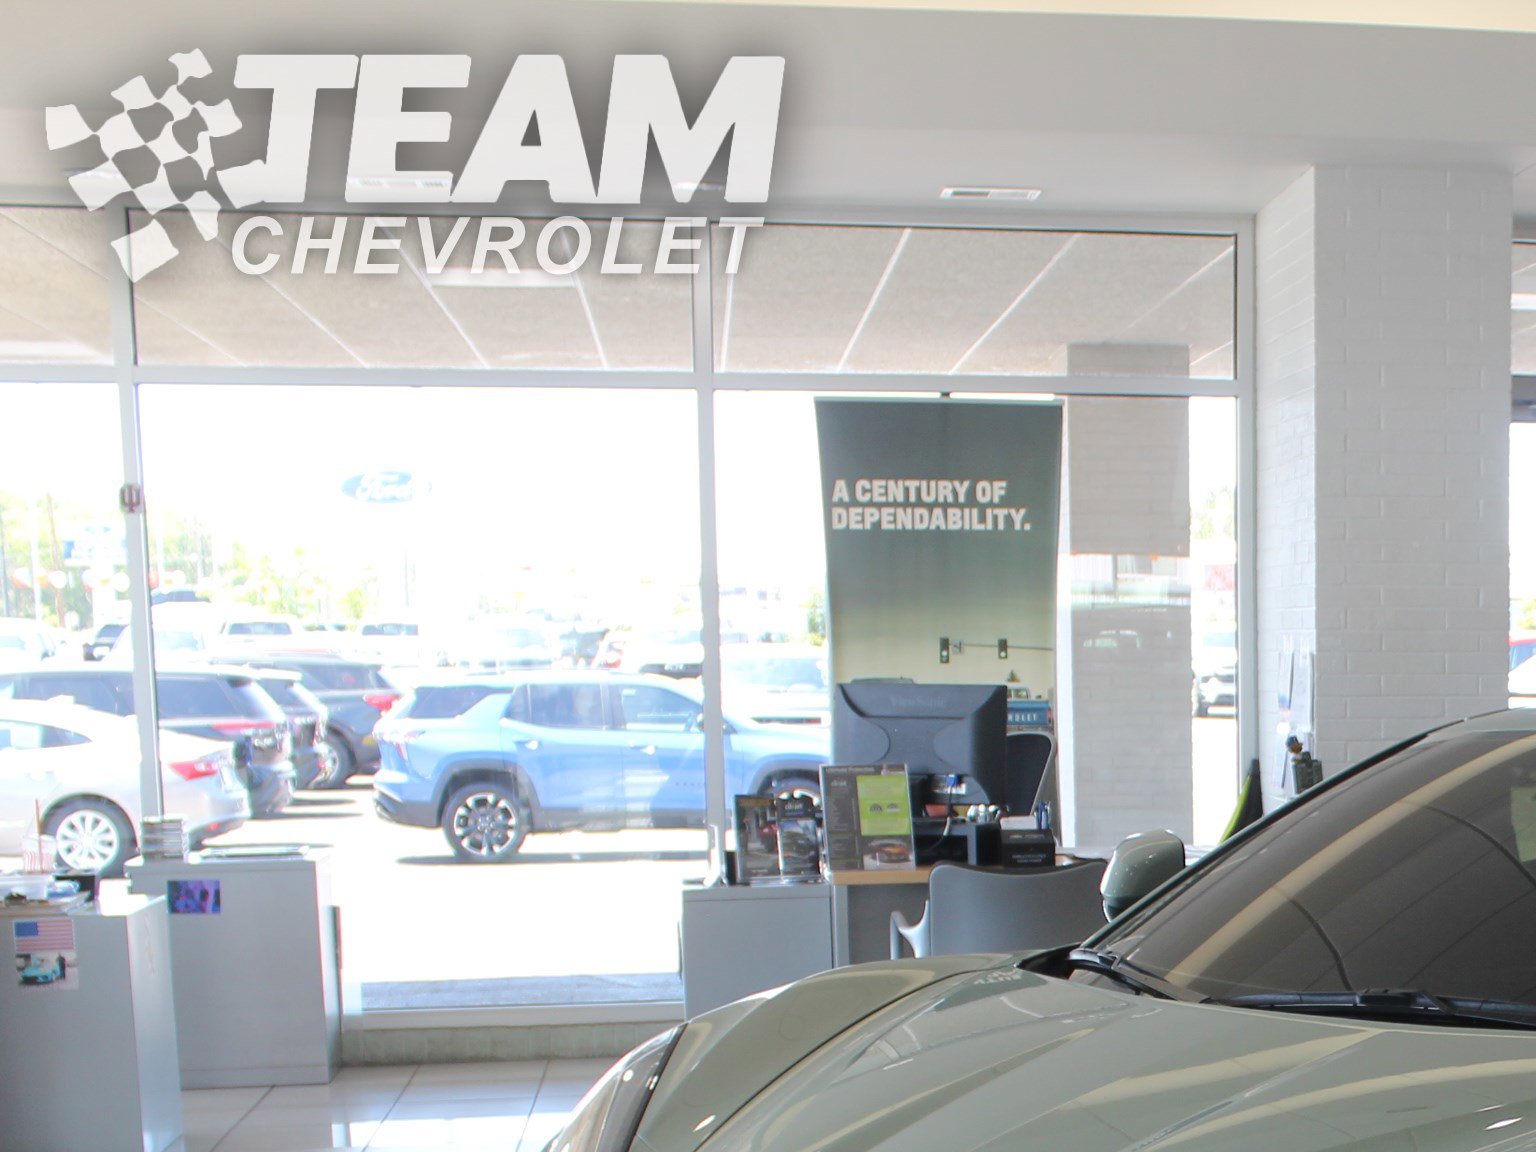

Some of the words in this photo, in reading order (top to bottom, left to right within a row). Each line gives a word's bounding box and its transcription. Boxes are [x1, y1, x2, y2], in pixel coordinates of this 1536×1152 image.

[832, 479, 850, 503] A
[854, 479, 970, 504] CENTURY
[975, 480, 1008, 504] OF
[831, 506, 1032, 531] DEPENDABILITY.
